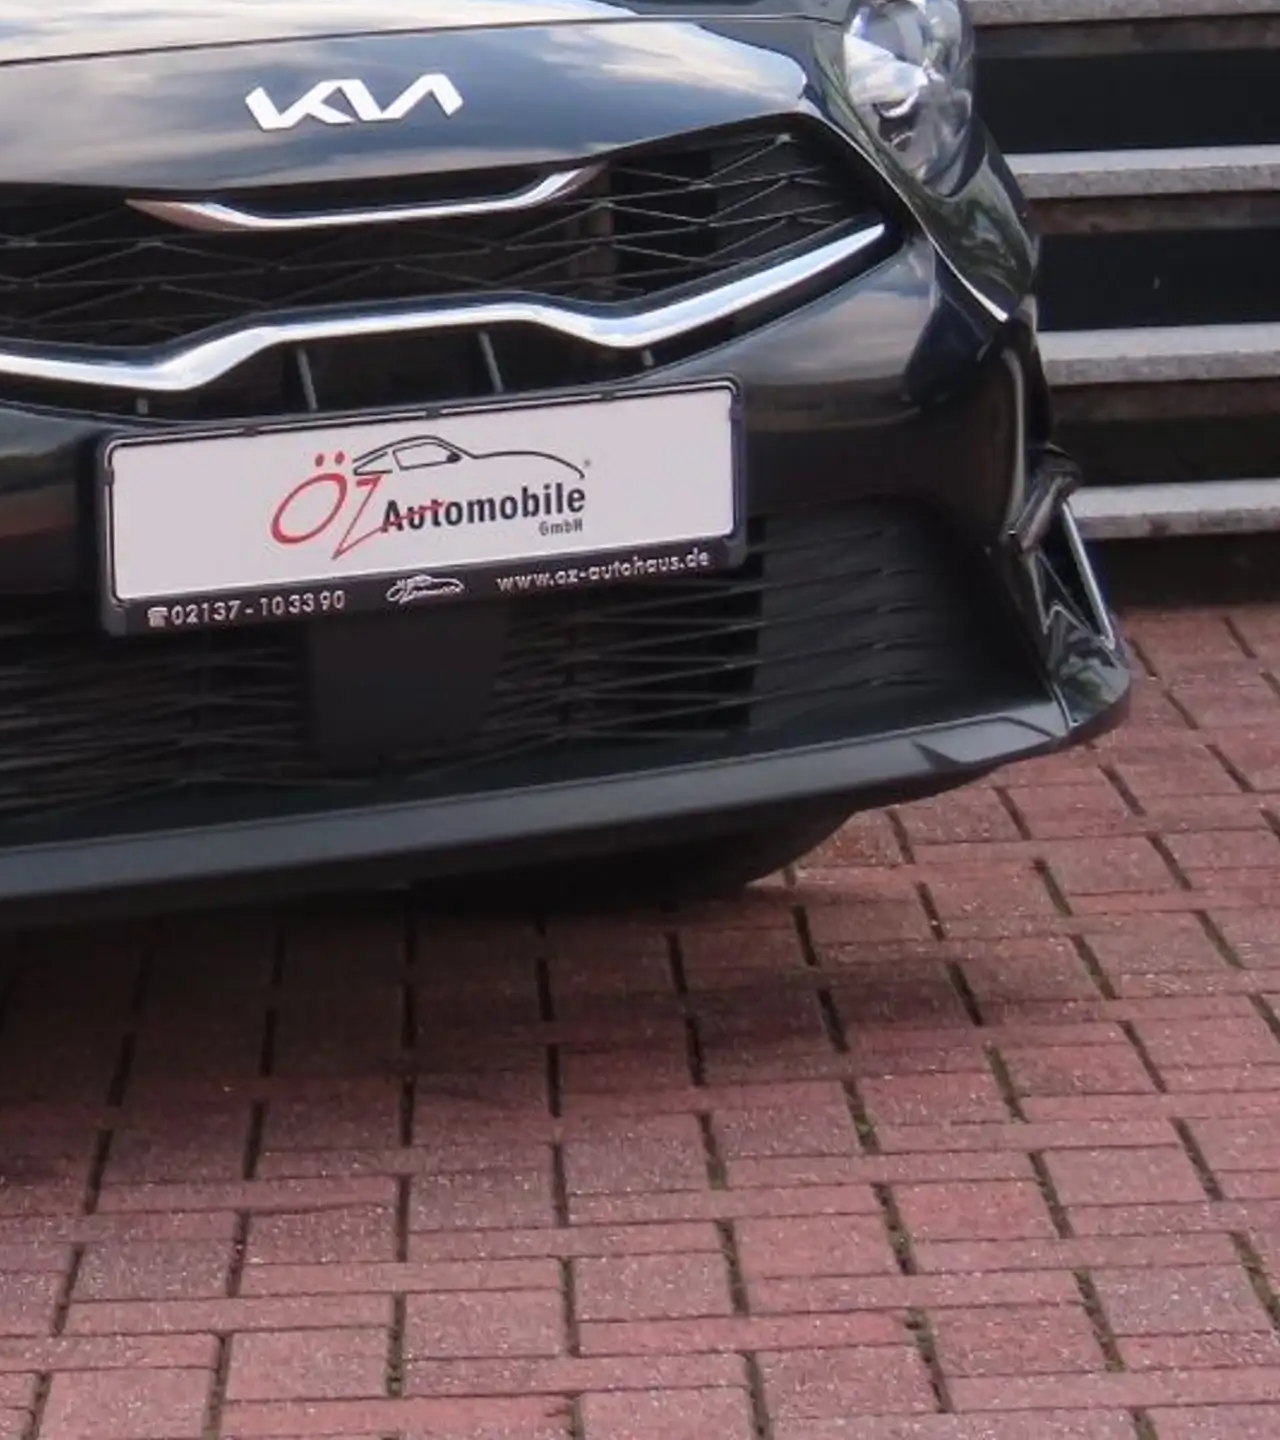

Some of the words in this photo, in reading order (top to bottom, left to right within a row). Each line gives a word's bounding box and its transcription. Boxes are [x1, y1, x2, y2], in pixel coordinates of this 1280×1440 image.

[244, 72, 465, 131] KIA
[380, 482, 586, 533] Automobile
[538, 517, 584, 537] GmbH
